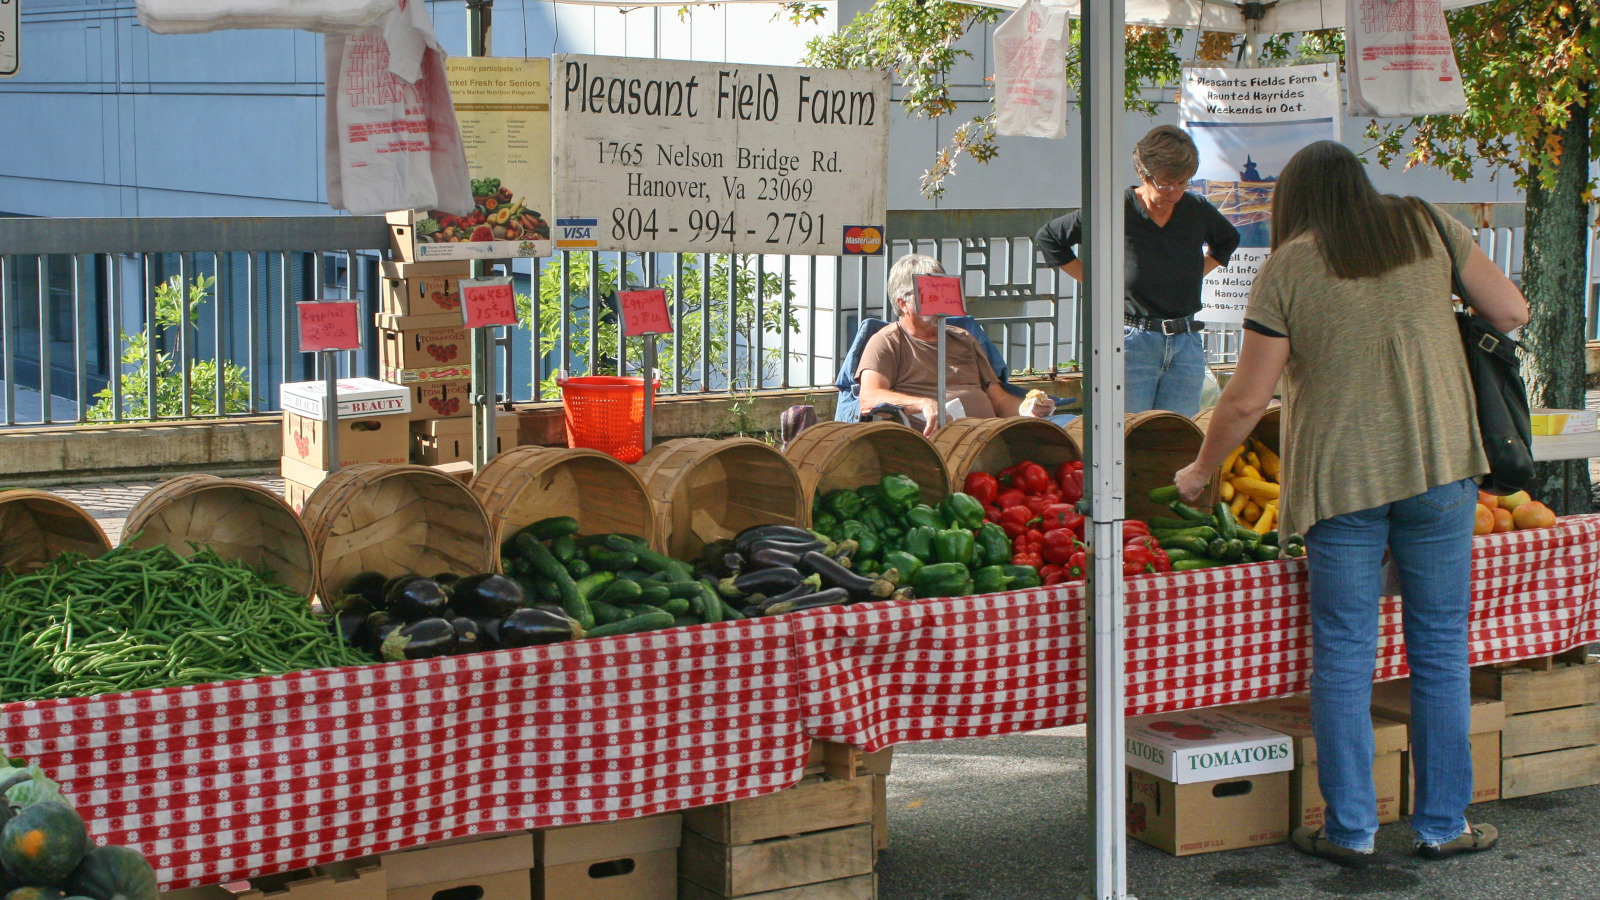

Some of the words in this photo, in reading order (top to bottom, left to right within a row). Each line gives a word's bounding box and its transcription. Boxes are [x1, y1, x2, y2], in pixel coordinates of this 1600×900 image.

[452, 65, 476, 73] proudly
[479, 65, 514, 73] participate
[470, 79, 493, 87] Fresh
[495, 79, 506, 87] for
[509, 79, 541, 88] Seniors
[1197, 77, 1247, 88] Pleasants
[1250, 77, 1286, 87] Fields
[1289, 75, 1317, 86] Farm
[512, 90, 536, 98] Program
[565, 61, 699, 118] Pleasant
[717, 69, 779, 122] Field
[798, 74, 875, 126] Farm
[1207, 91, 1249, 101] Haunted
[1253, 89, 1305, 102] Hayrides
[1206, 104, 1263, 114] Weekends
[1266, 104, 1276, 113] in
[598, 142, 643, 165] 1765
[656, 144, 724, 168] Nelson
[737, 147, 800, 176] Bridge
[812, 151, 842, 173] Rd.
[627, 173, 710, 203] Hanover,
[722, 176, 746, 200] Va
[757, 177, 813, 202] 23069
[612, 208, 658, 241] 804
[688, 210, 737, 243] 994
[765, 211, 826, 245] 2791
[563, 228, 591, 242] VISA
[845, 236, 881, 246] MasterCard
[1230, 254, 1240, 262] all
[1244, 254, 1260, 262] for
[1217, 266, 1233, 274] and
[1222, 278, 1252, 286] Nelso
[421, 331, 465, 344] TOMATOES
[352, 399, 404, 413] BEAUTY
[1187, 743, 1289, 771] TOMATOES
